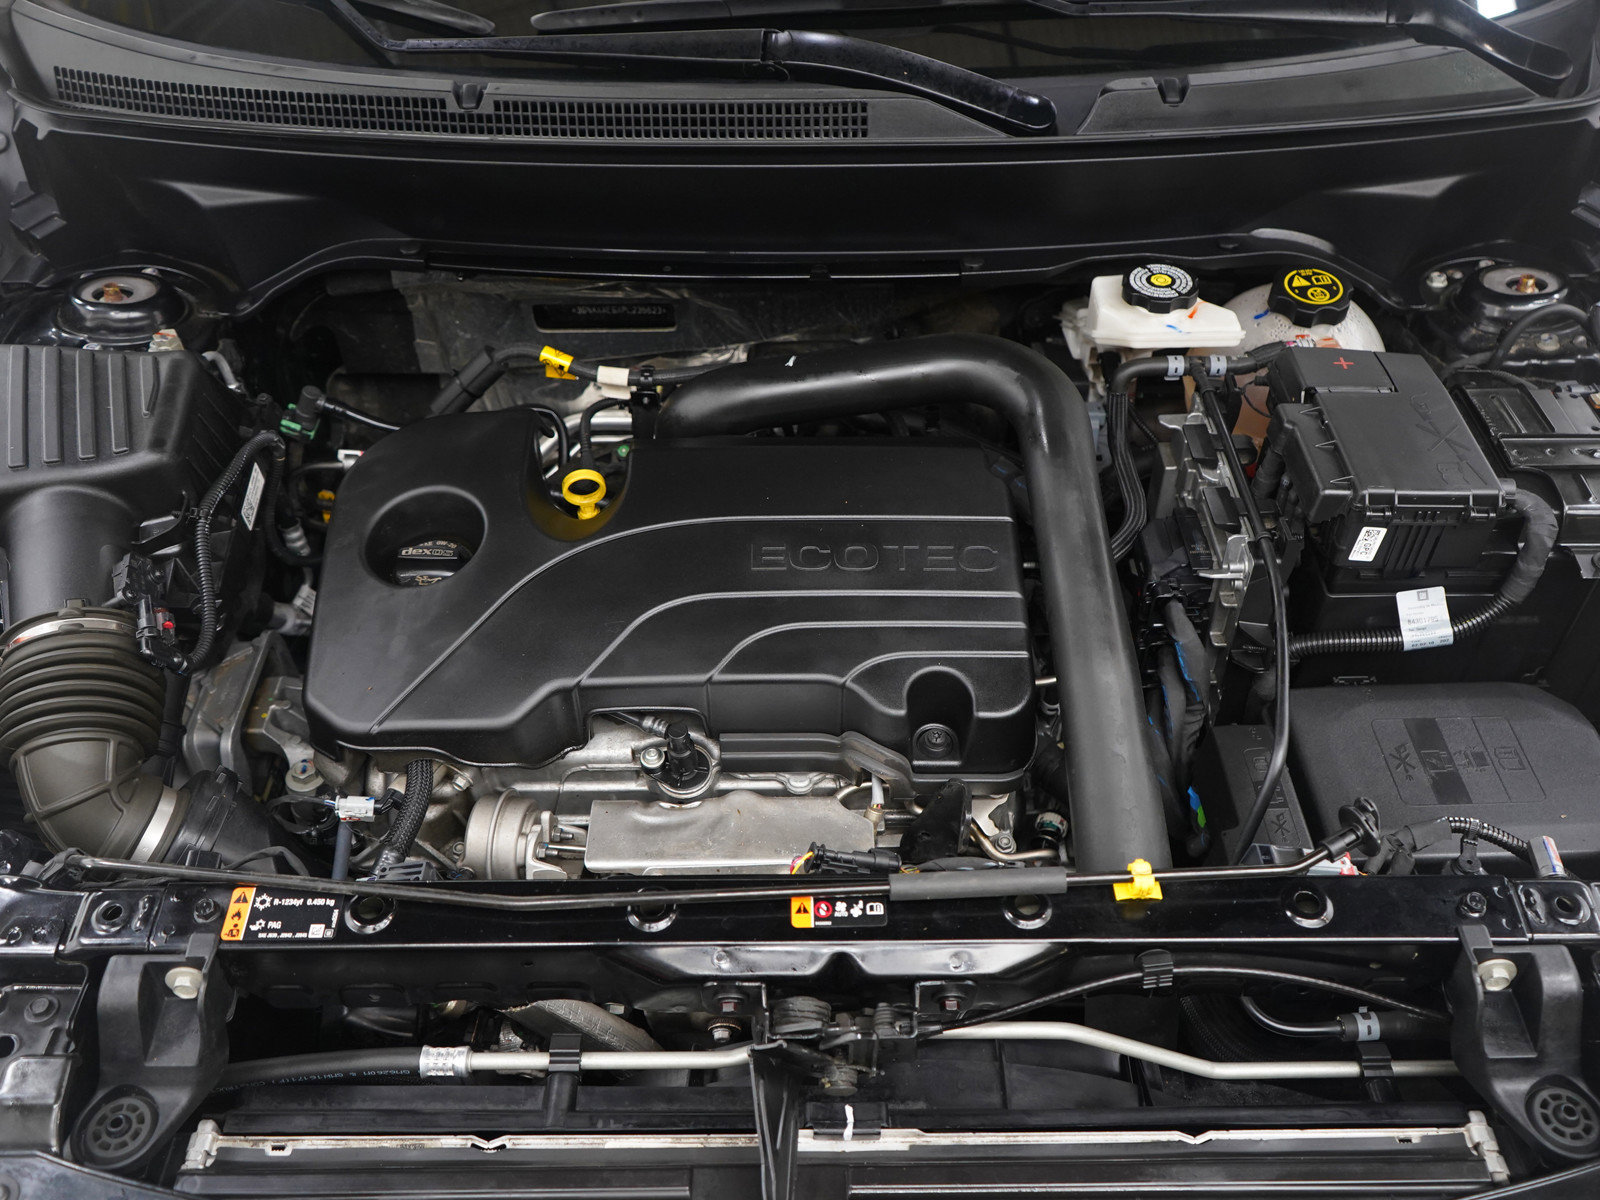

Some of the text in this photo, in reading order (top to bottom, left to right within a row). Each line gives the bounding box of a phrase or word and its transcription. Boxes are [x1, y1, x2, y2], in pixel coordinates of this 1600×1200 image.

[401, 547, 454, 556] dexos
[750, 544, 999, 573] ECOTEC
[273, 898, 335, 907] R-1234yf 0.450 kg
[267, 921, 282, 929] PAG
